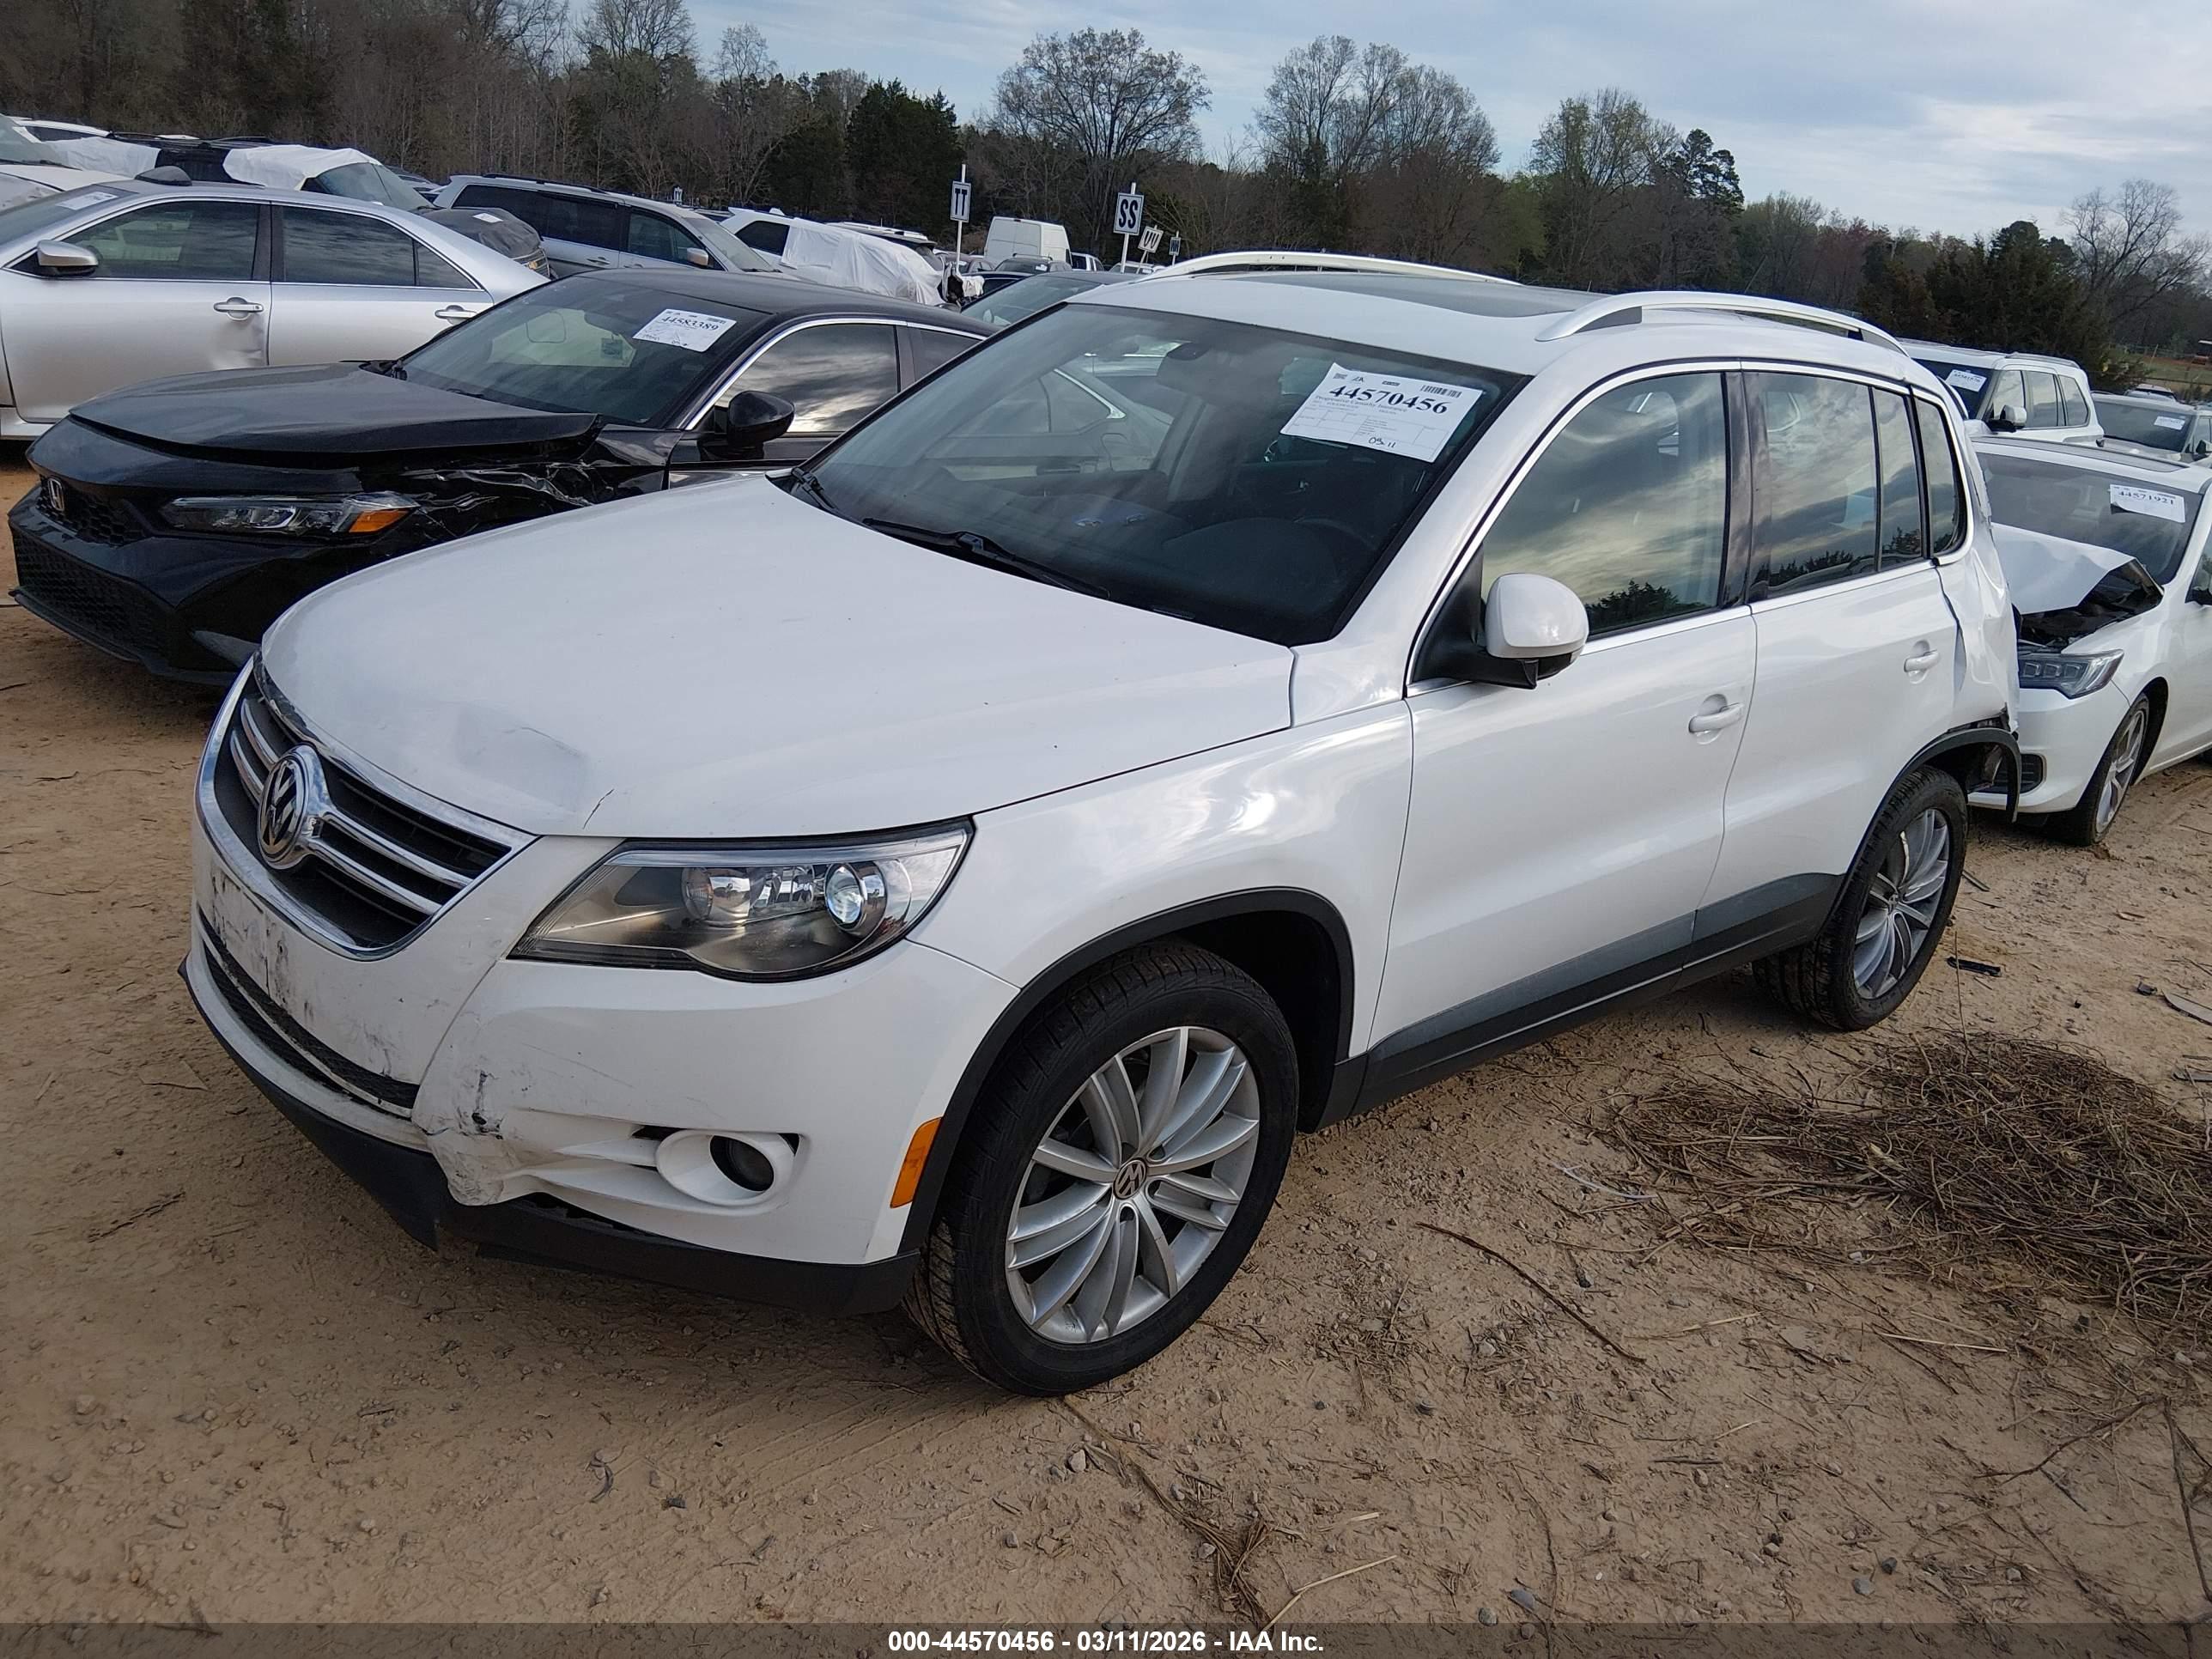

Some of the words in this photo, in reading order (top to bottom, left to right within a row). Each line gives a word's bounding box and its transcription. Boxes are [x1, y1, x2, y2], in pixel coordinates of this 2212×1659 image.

[954, 187, 968, 216] TT
[1119, 198, 1139, 229] SS
[660, 316, 720, 331] 44583389
[1328, 385, 1451, 414] 44570456
[2118, 490, 2174, 505] 44571921
